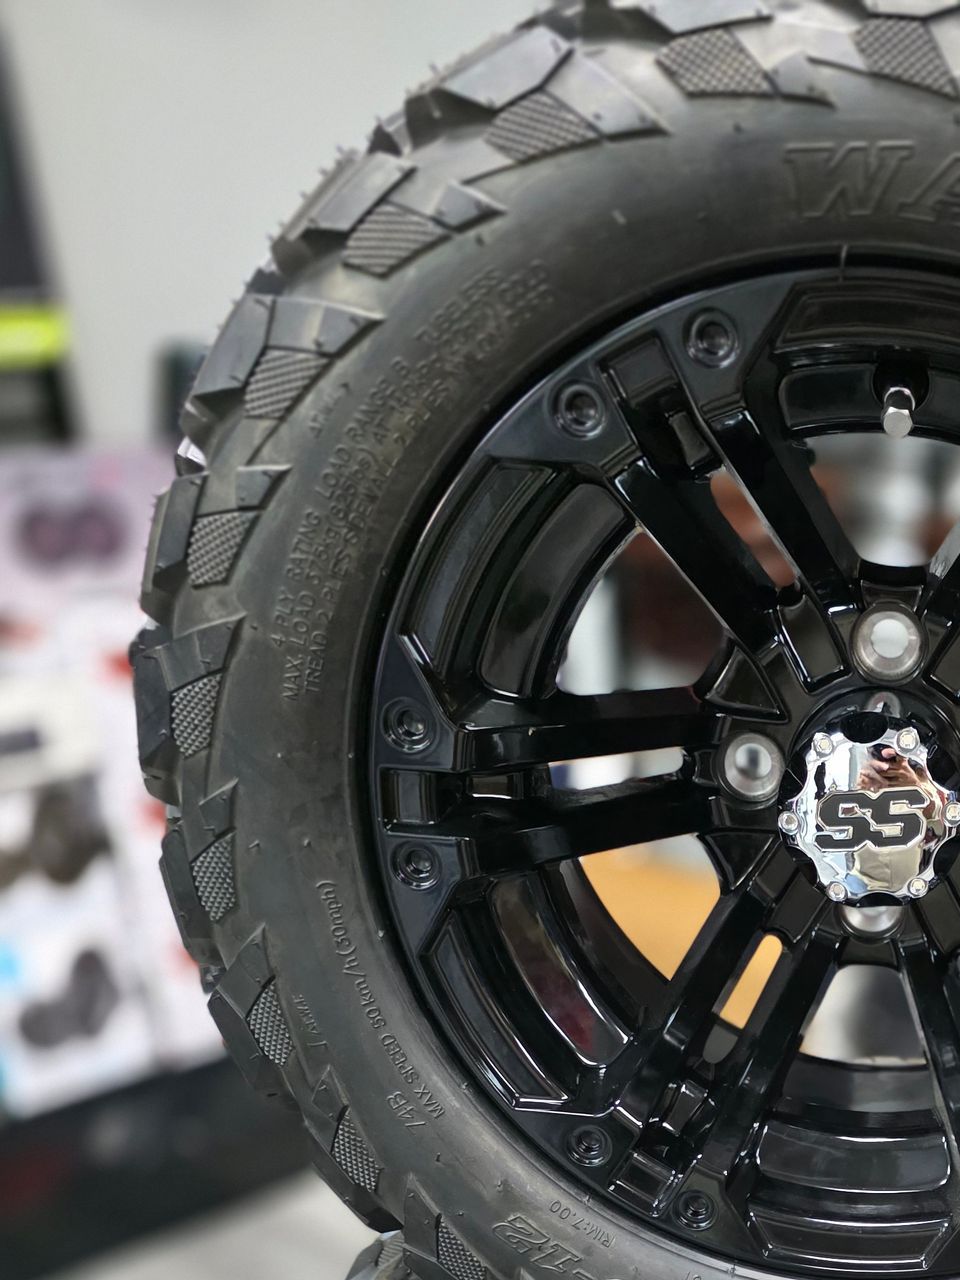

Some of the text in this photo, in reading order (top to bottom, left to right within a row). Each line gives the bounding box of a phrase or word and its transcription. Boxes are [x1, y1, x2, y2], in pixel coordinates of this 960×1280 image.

[344, 375, 396, 443] RANGE
[313, 442, 354, 500] LOAD
[282, 506, 322, 581] RATING
[272, 585, 296, 625] PLY
[289, 588, 316, 645] LOAD
[303, 630, 327, 694] TREAD
[322, 547, 351, 601] PLIES
[813, 786, 927, 852] SS
[379, 1032, 420, 1085] SPEED
[385, 1088, 427, 1136] 74B
[413, 1083, 446, 1120] MAX
